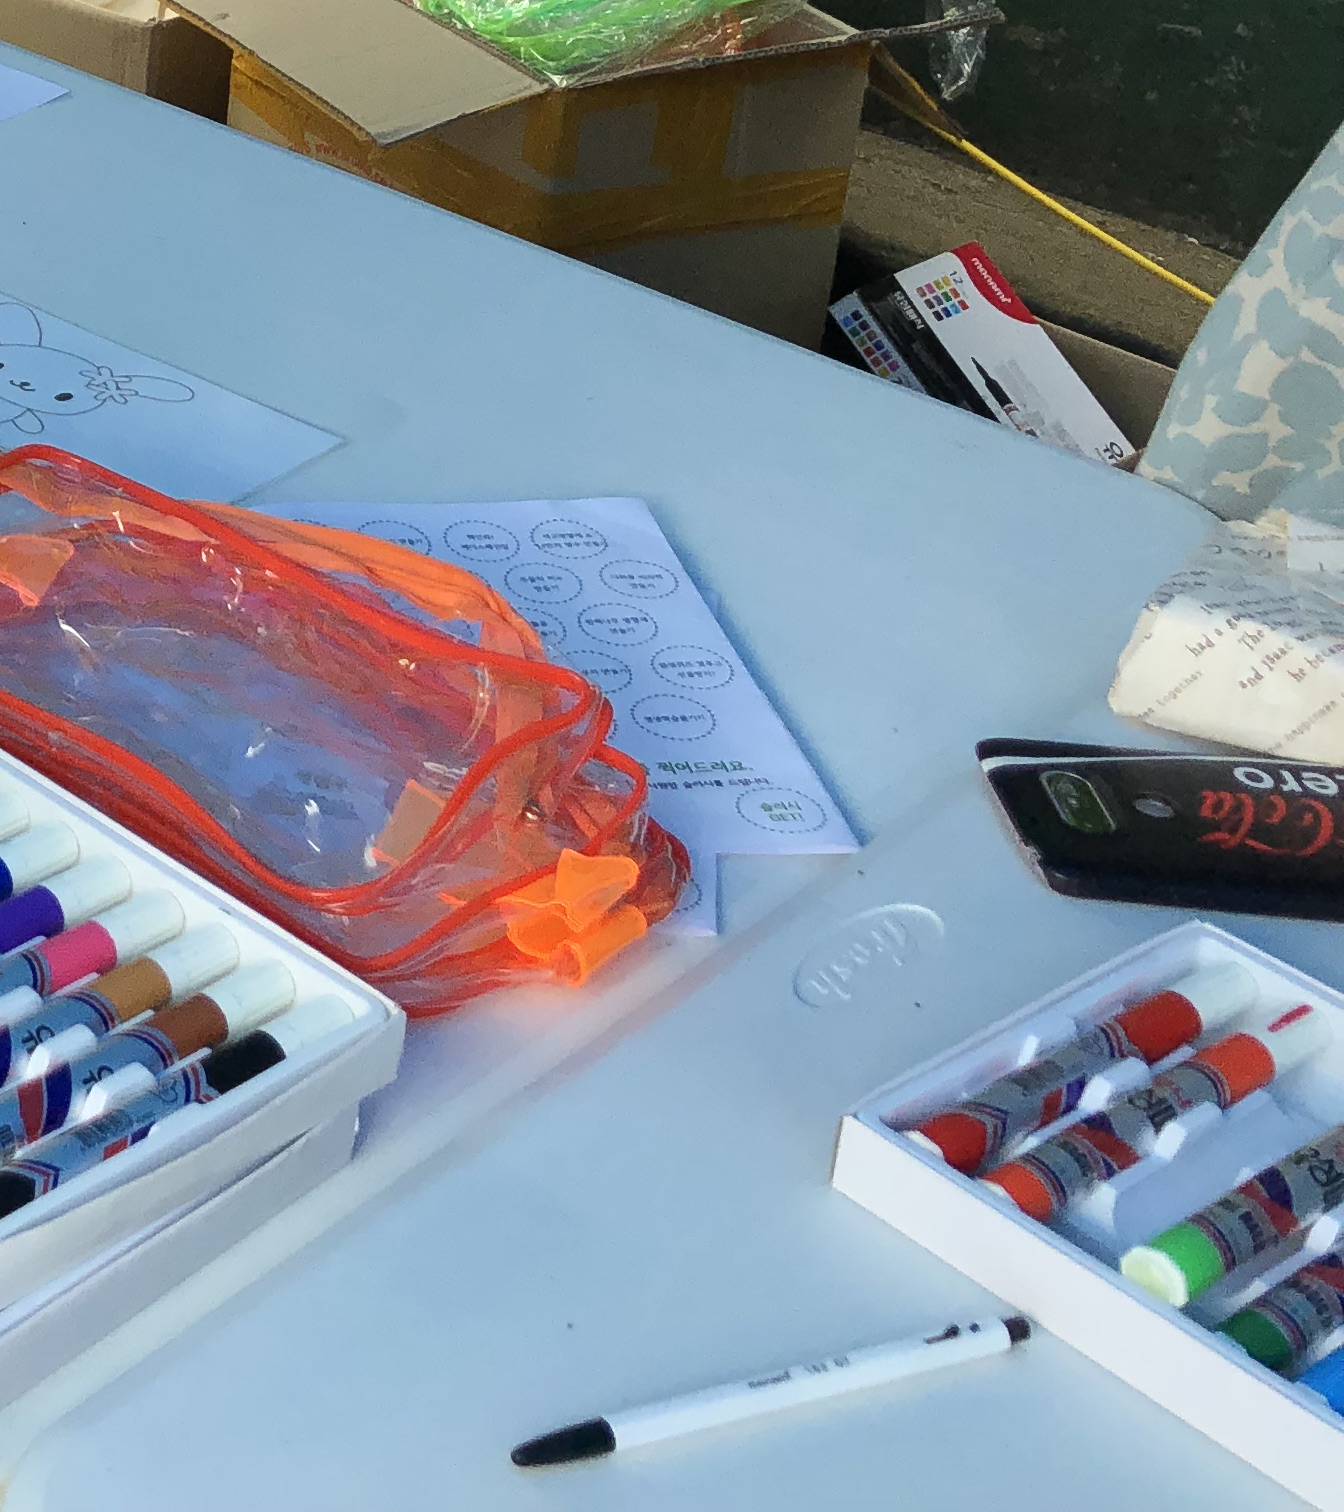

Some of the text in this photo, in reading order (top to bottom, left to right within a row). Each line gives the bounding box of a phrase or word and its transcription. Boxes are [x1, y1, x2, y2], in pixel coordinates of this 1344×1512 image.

[971, 257, 1013, 305] monami
[1185, 634, 1215, 657] had
[1238, 628, 1266, 651] The
[1238, 666, 1264, 690] and
[1286, 667, 1308, 683] he
[656, 760, 754, 775] 찍어드려요.
[760, 800, 802, 813] 슬러시
